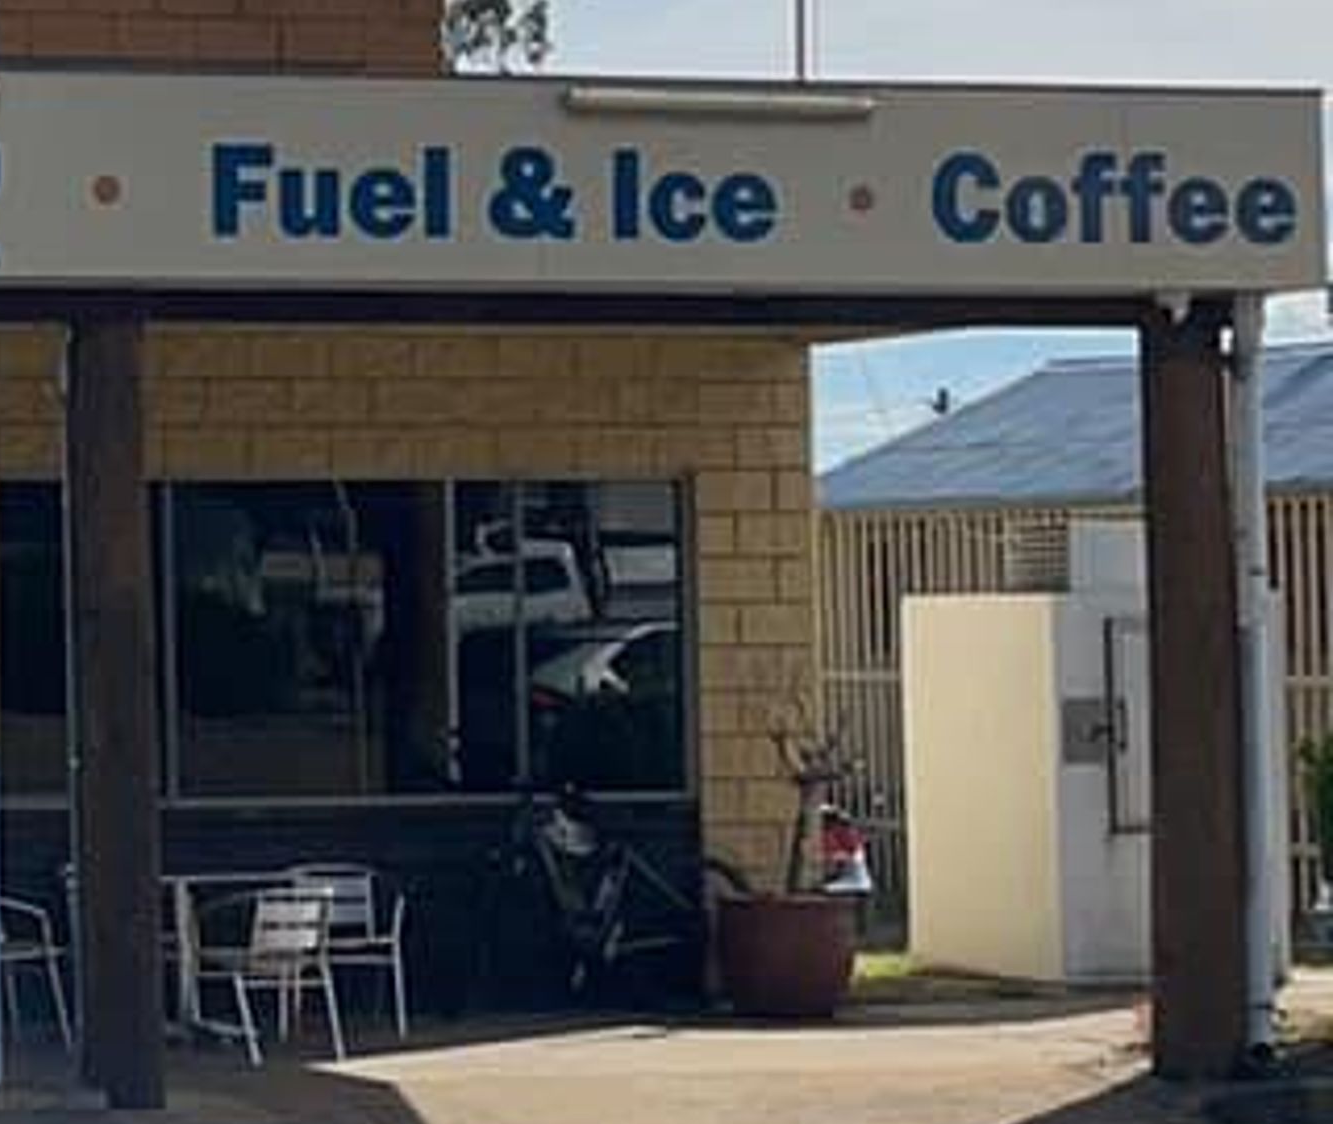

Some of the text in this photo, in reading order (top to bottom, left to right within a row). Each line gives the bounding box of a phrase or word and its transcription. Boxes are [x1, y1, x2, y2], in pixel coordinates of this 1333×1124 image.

[211, 143, 776, 243] Fuel & Ice
[932, 152, 1297, 246] Coffee
